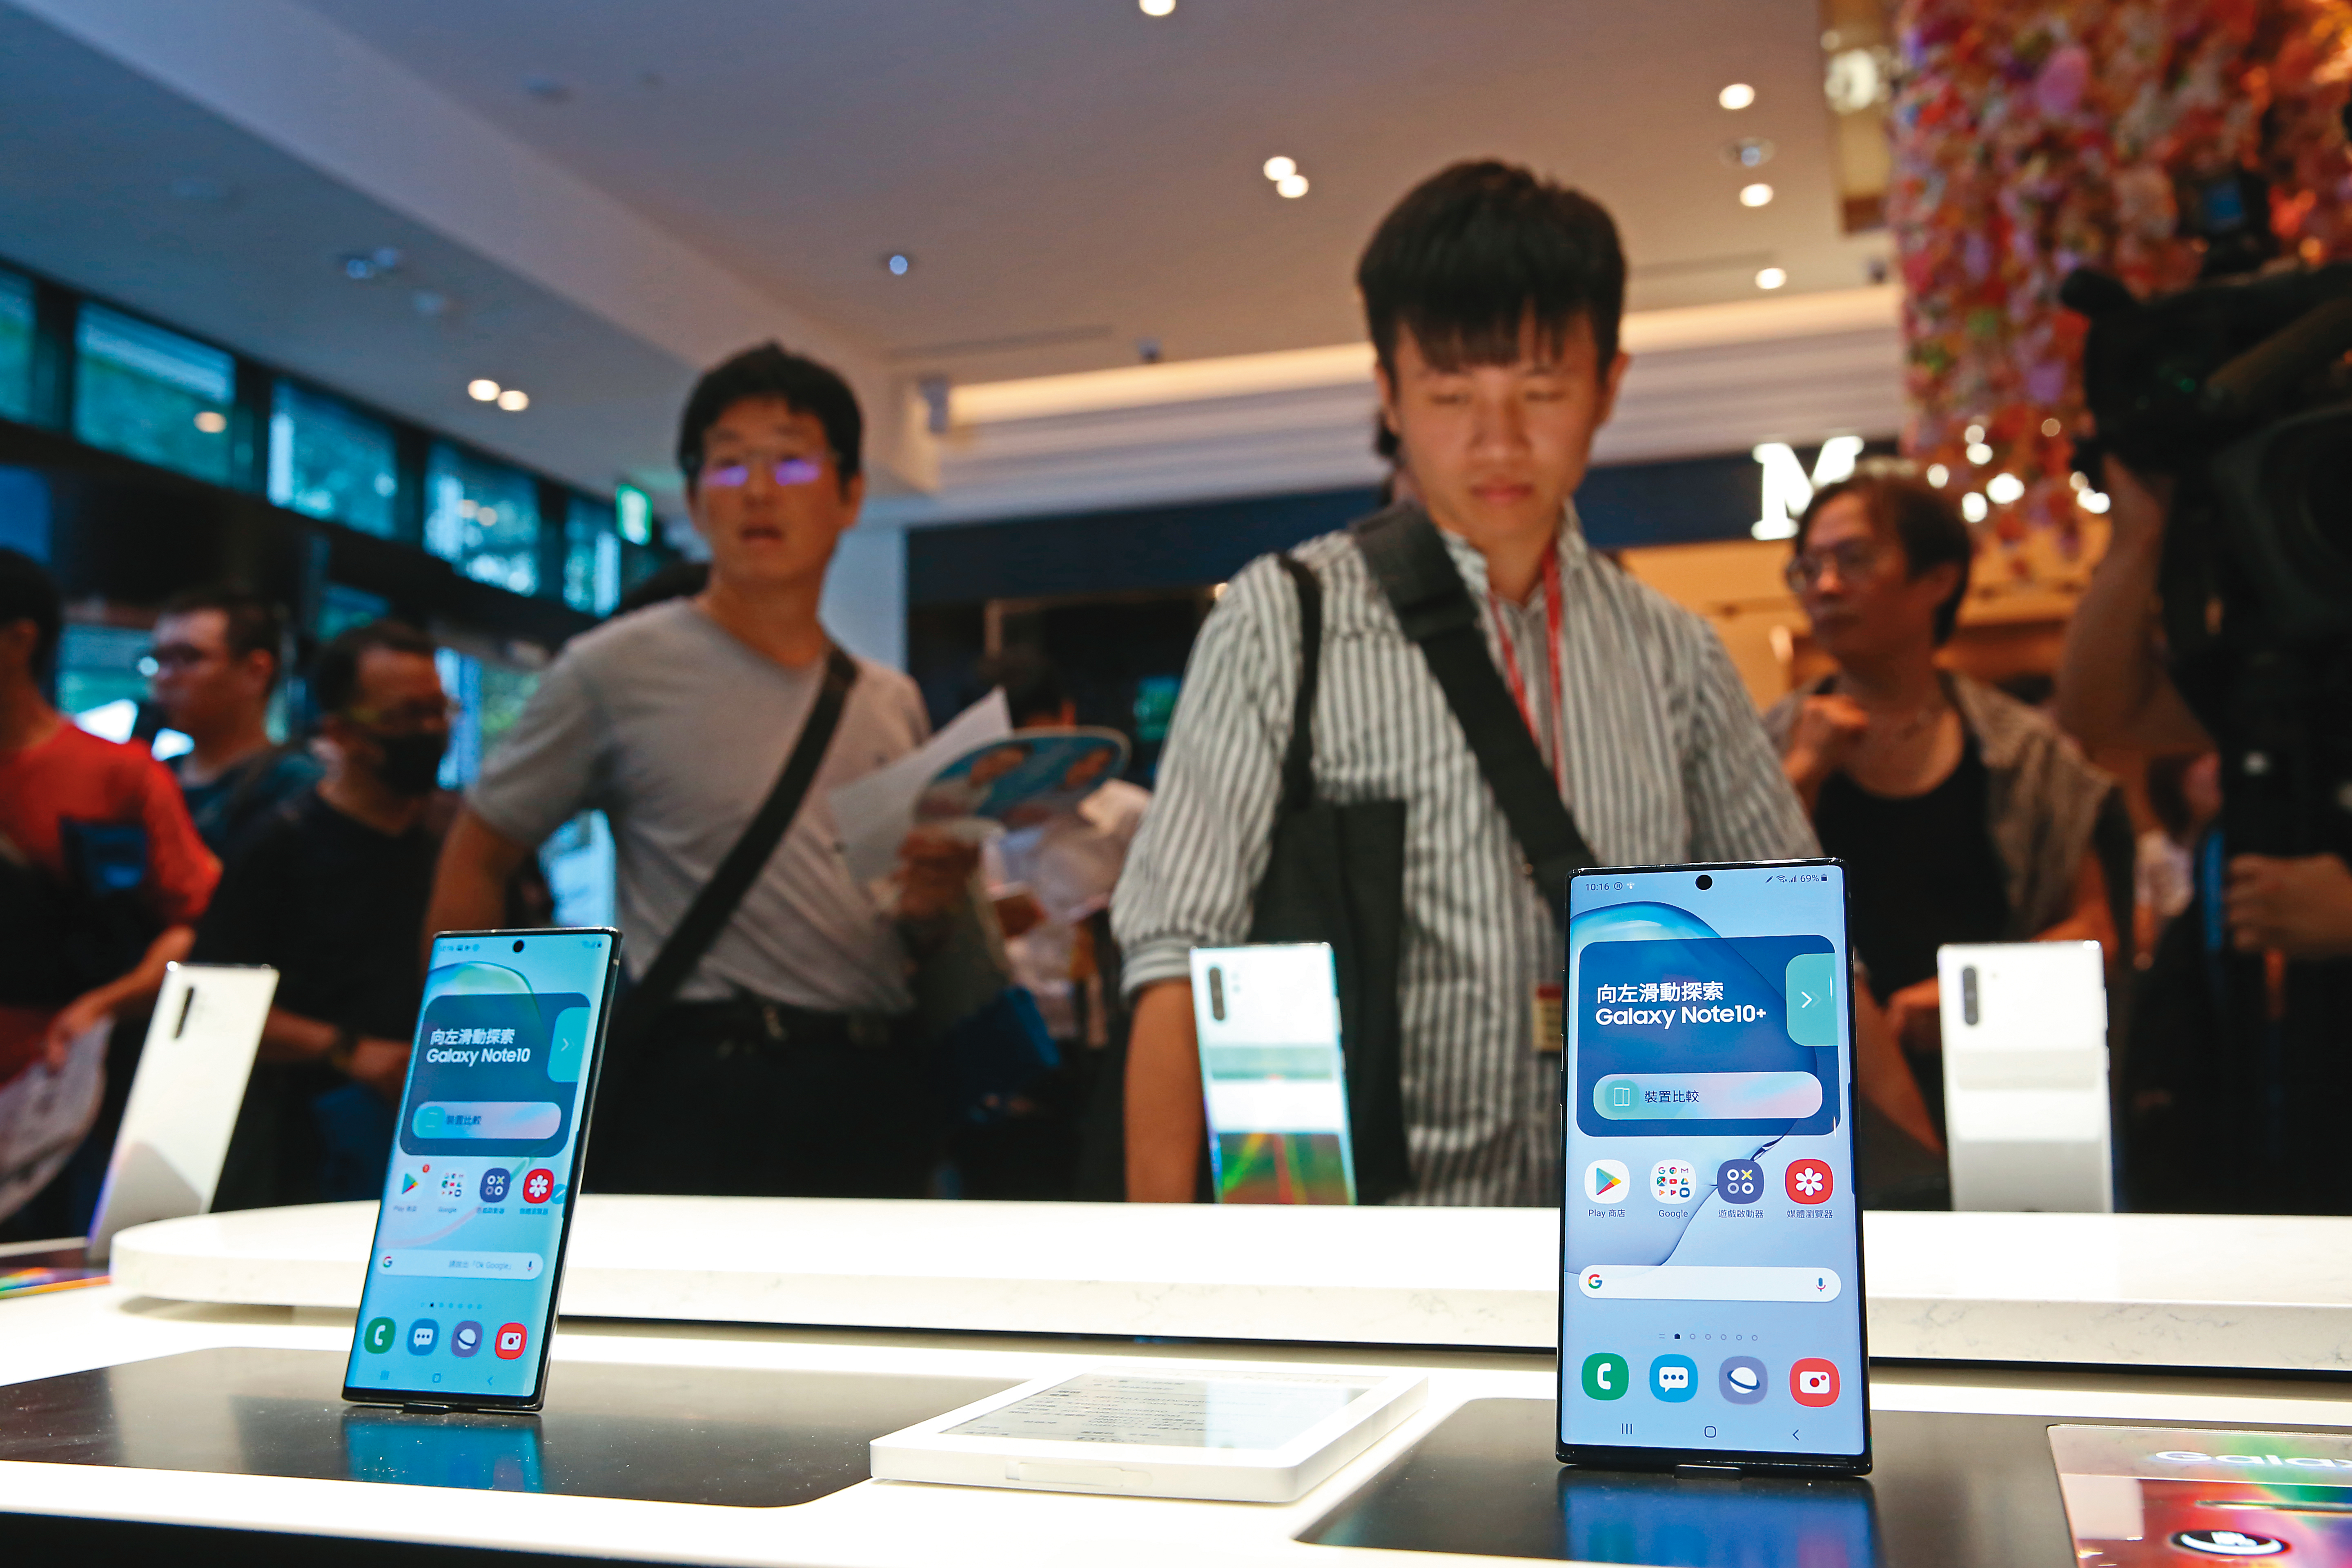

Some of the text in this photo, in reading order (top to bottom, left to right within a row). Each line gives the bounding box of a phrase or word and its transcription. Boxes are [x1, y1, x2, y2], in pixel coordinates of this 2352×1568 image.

[1800, 874, 1819, 882] 69%
[1585, 883, 1610, 891] 10:16
[1597, 981, 1724, 1004] 向左滑動探索
[1595, 1004, 1766, 1029] Galaxy Note10+
[430, 1027, 516, 1045] 向左滑動探索
[426, 1047, 531, 1067] Galaxy Note10
[1645, 1090, 1699, 1103] 裝置比較
[1588, 1209, 1626, 1218] Play 商店
[1658, 1209, 1688, 1218] Google
[1786, 1209, 1833, 1218] 媒體瀏覽器
